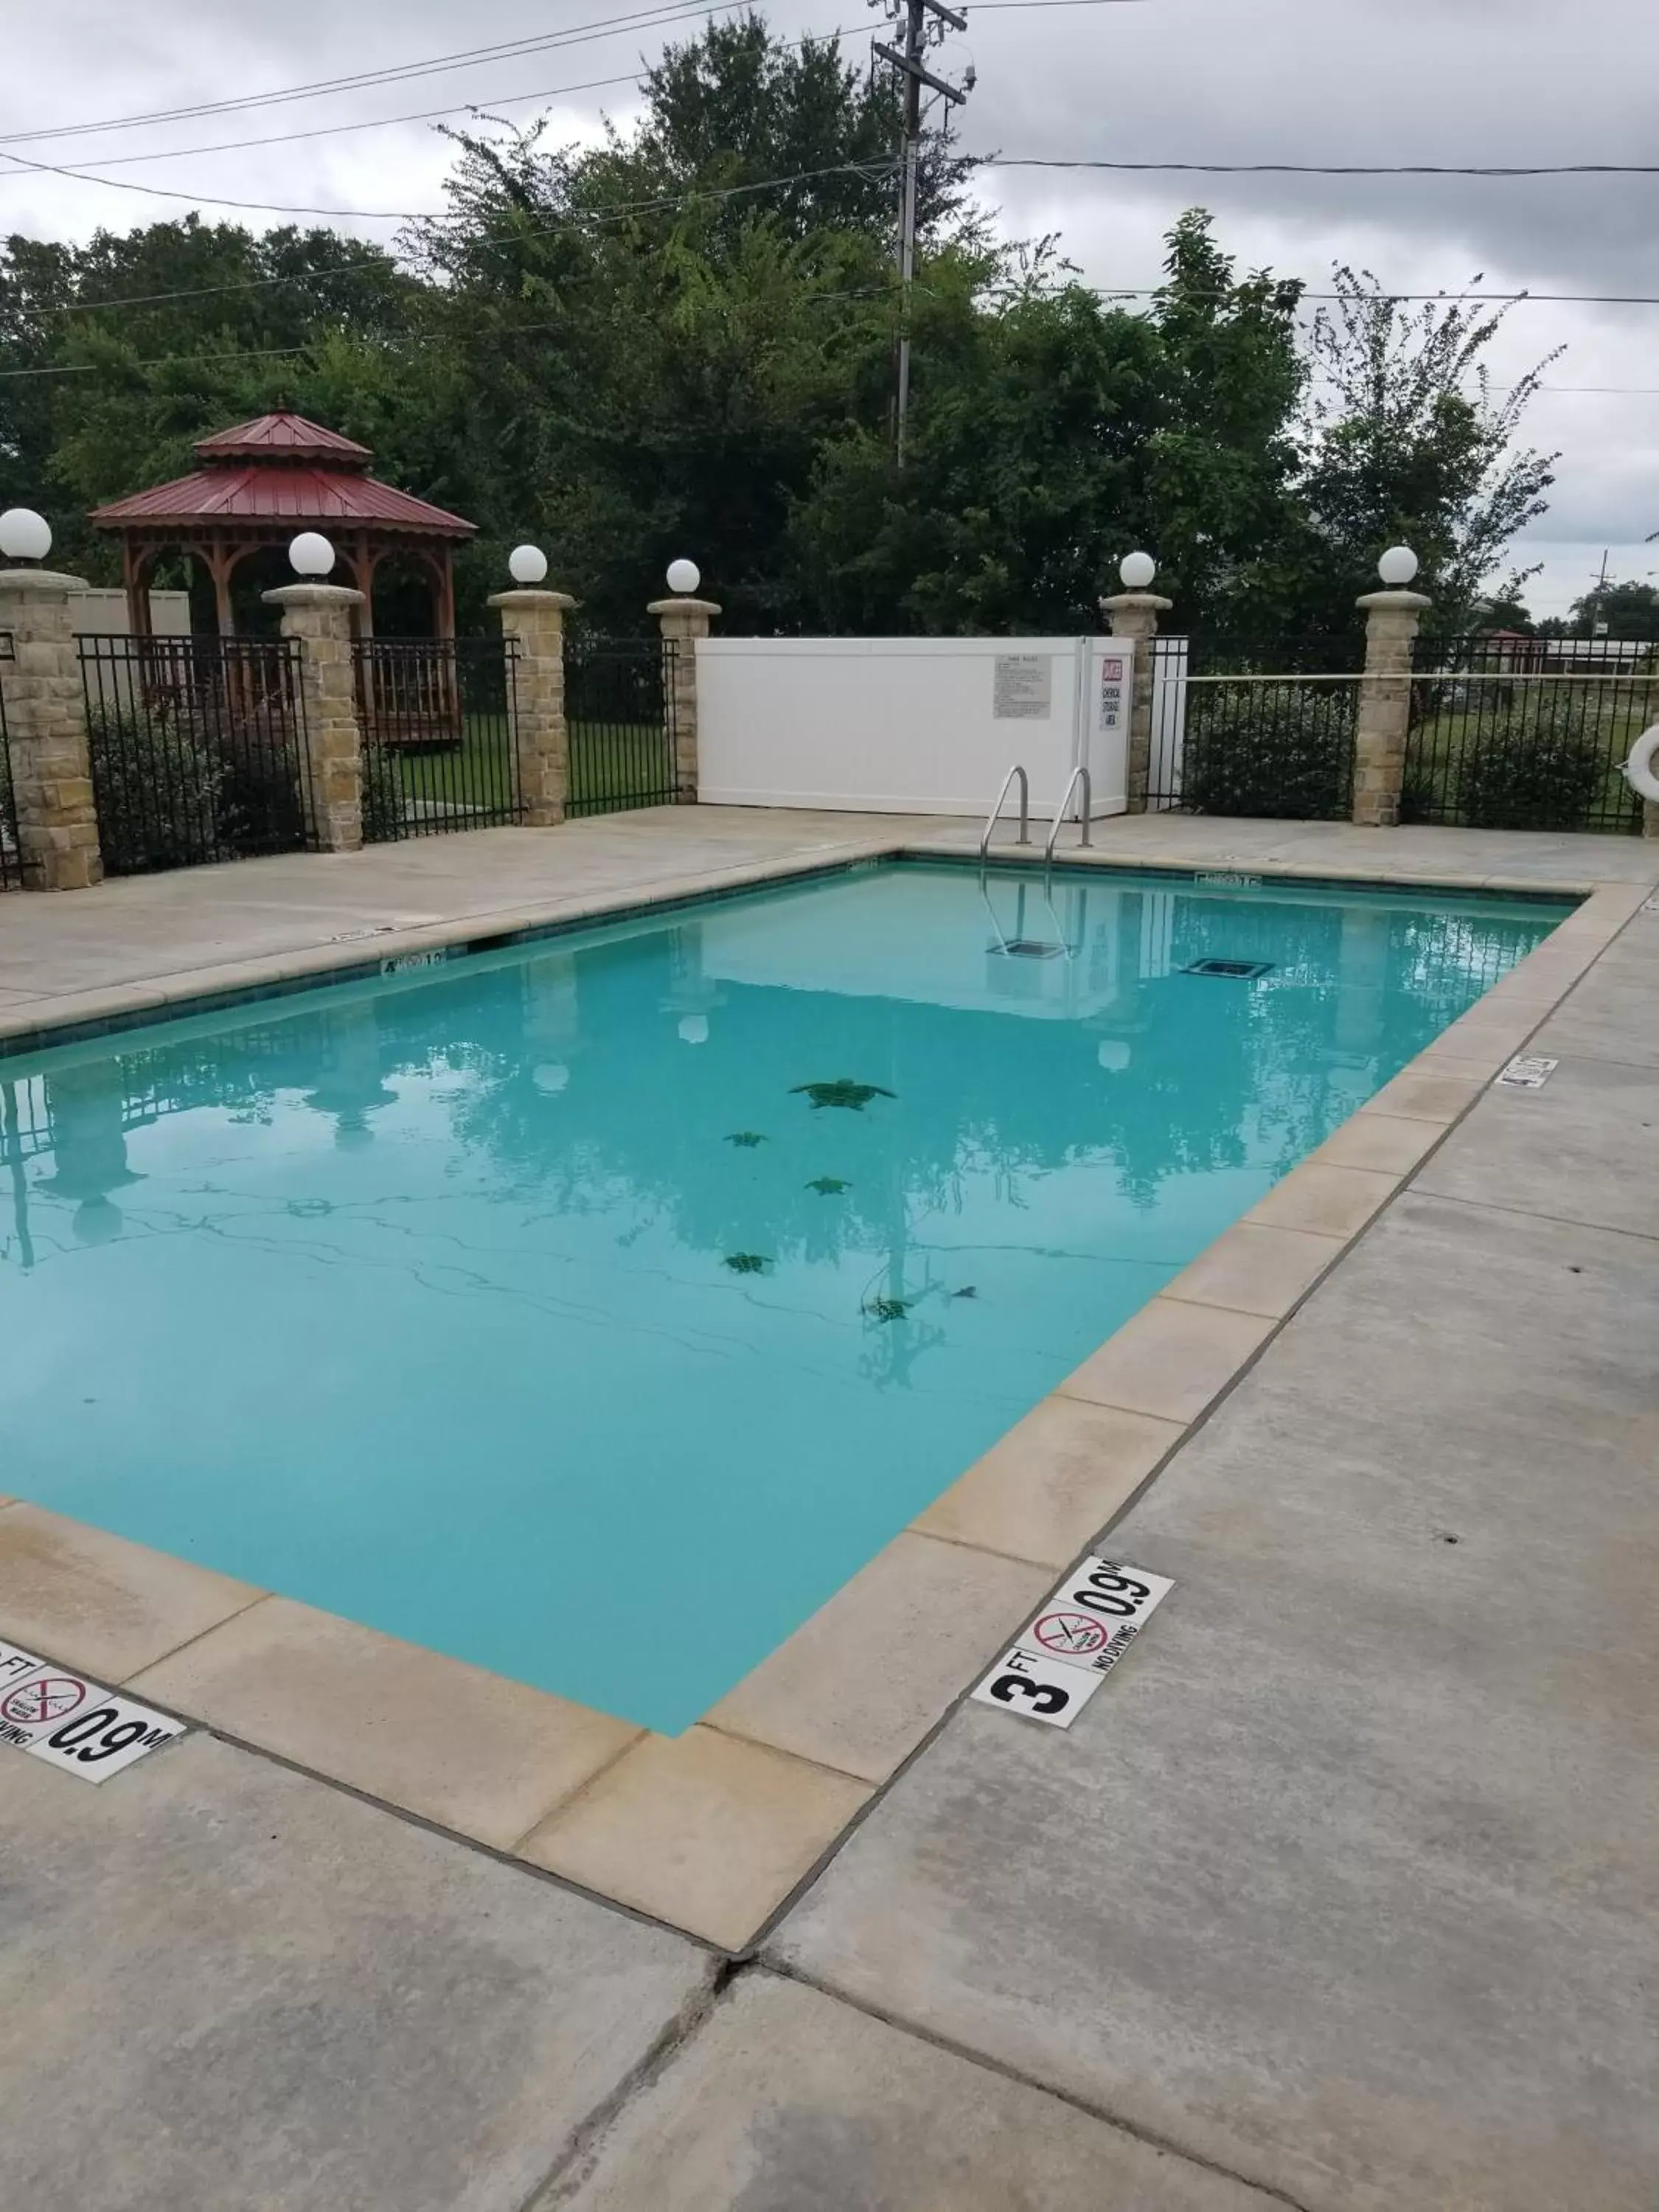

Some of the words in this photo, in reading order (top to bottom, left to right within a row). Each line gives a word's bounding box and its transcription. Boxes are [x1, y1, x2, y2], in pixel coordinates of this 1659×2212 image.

[1006, 1651, 1038, 1673] FT
[1092, 1655, 1113, 1670] NO
[1103, 1624, 1138, 1658] DIVING
[990, 1674, 1069, 1714] 3
